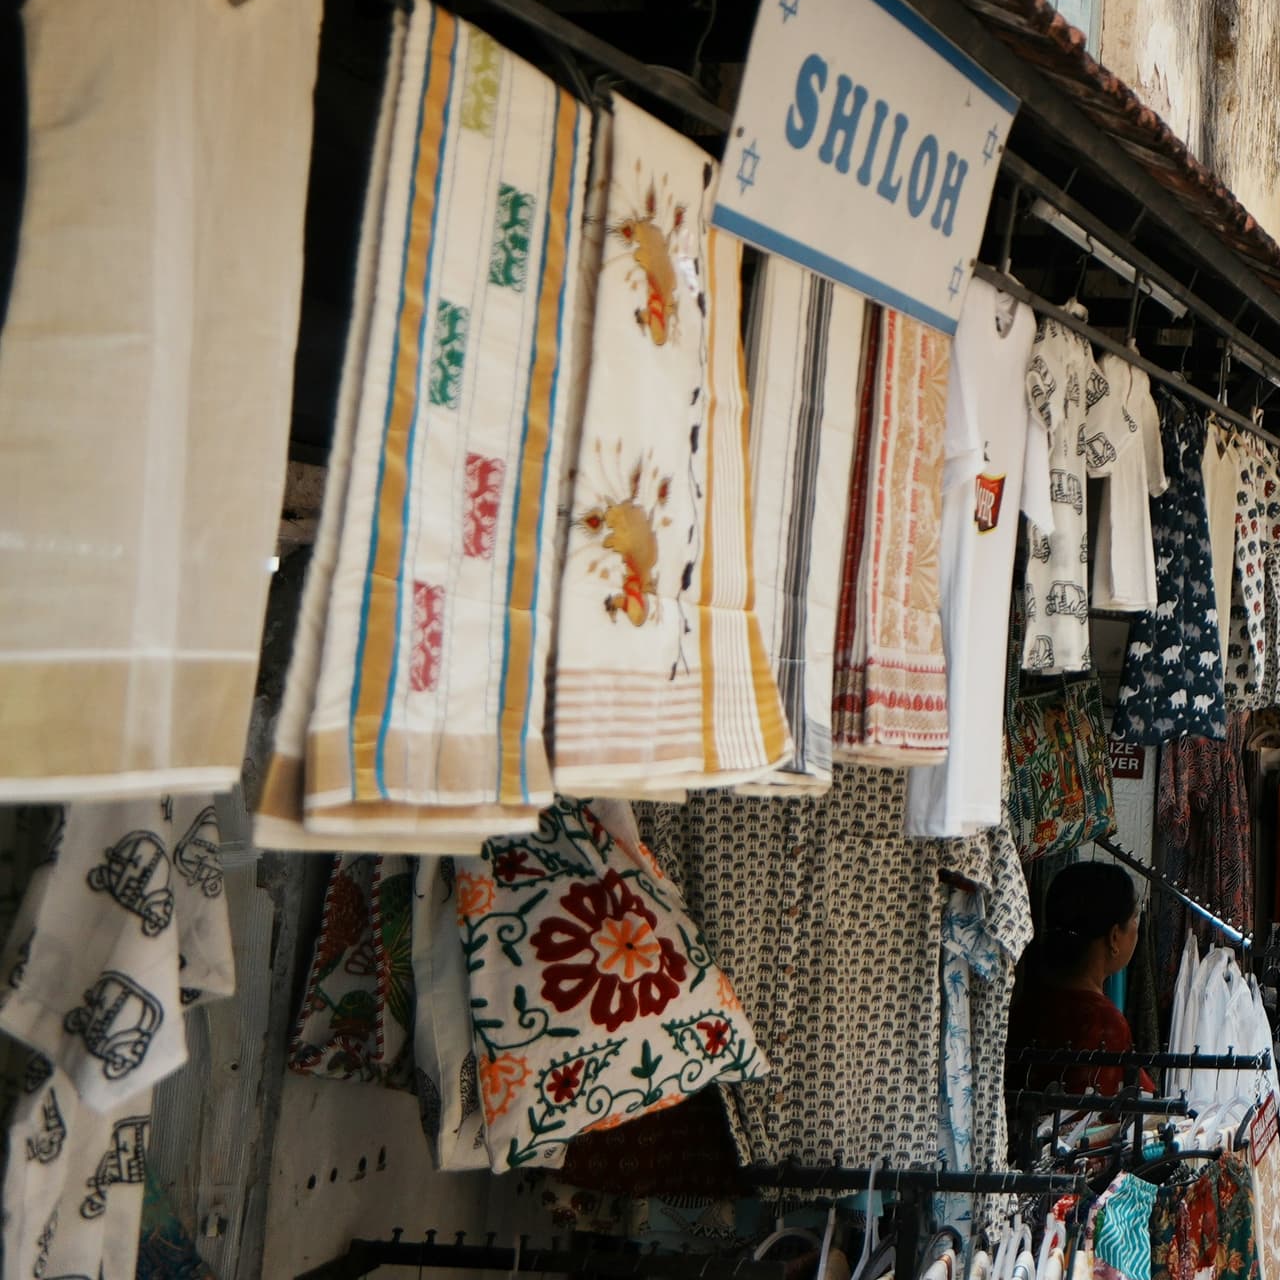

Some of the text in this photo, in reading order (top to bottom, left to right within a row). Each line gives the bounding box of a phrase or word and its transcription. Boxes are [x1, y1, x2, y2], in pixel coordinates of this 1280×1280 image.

[785, 54, 969, 238] SHILOH
[1109, 741, 1135, 754] IZE
[1111, 756, 1140, 770] VER
